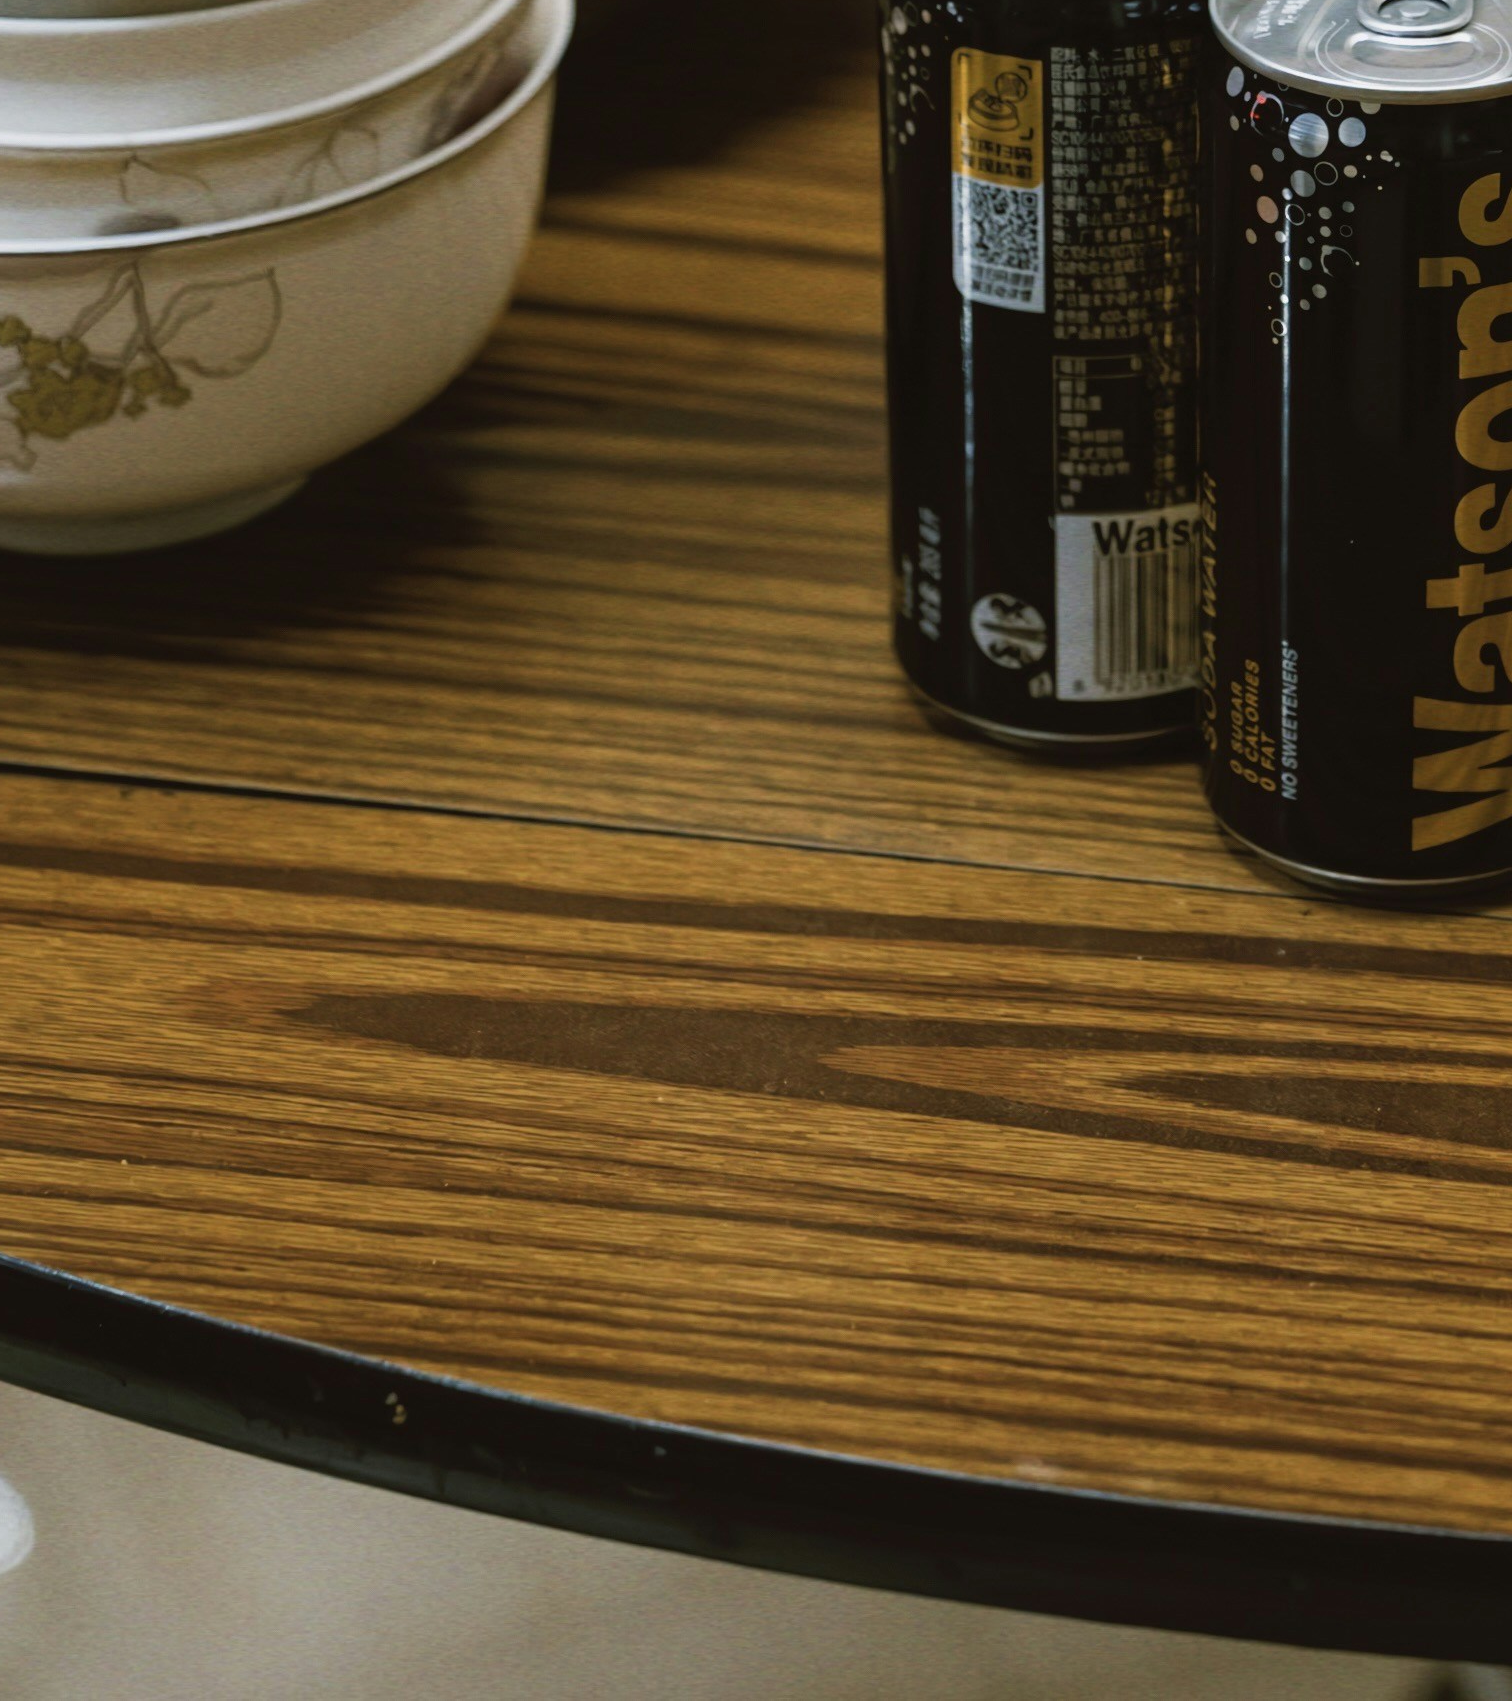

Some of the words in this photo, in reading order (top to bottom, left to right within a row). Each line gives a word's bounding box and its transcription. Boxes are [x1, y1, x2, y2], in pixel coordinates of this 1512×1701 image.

[1201, 470, 1218, 619] WATER
[1201, 629, 1219, 752] SODA
[1229, 679, 1245, 756] SUGAR
[1244, 658, 1260, 764] CALORIES
[1261, 730, 1276, 772] FAT
[1281, 772, 1299, 801] NO
